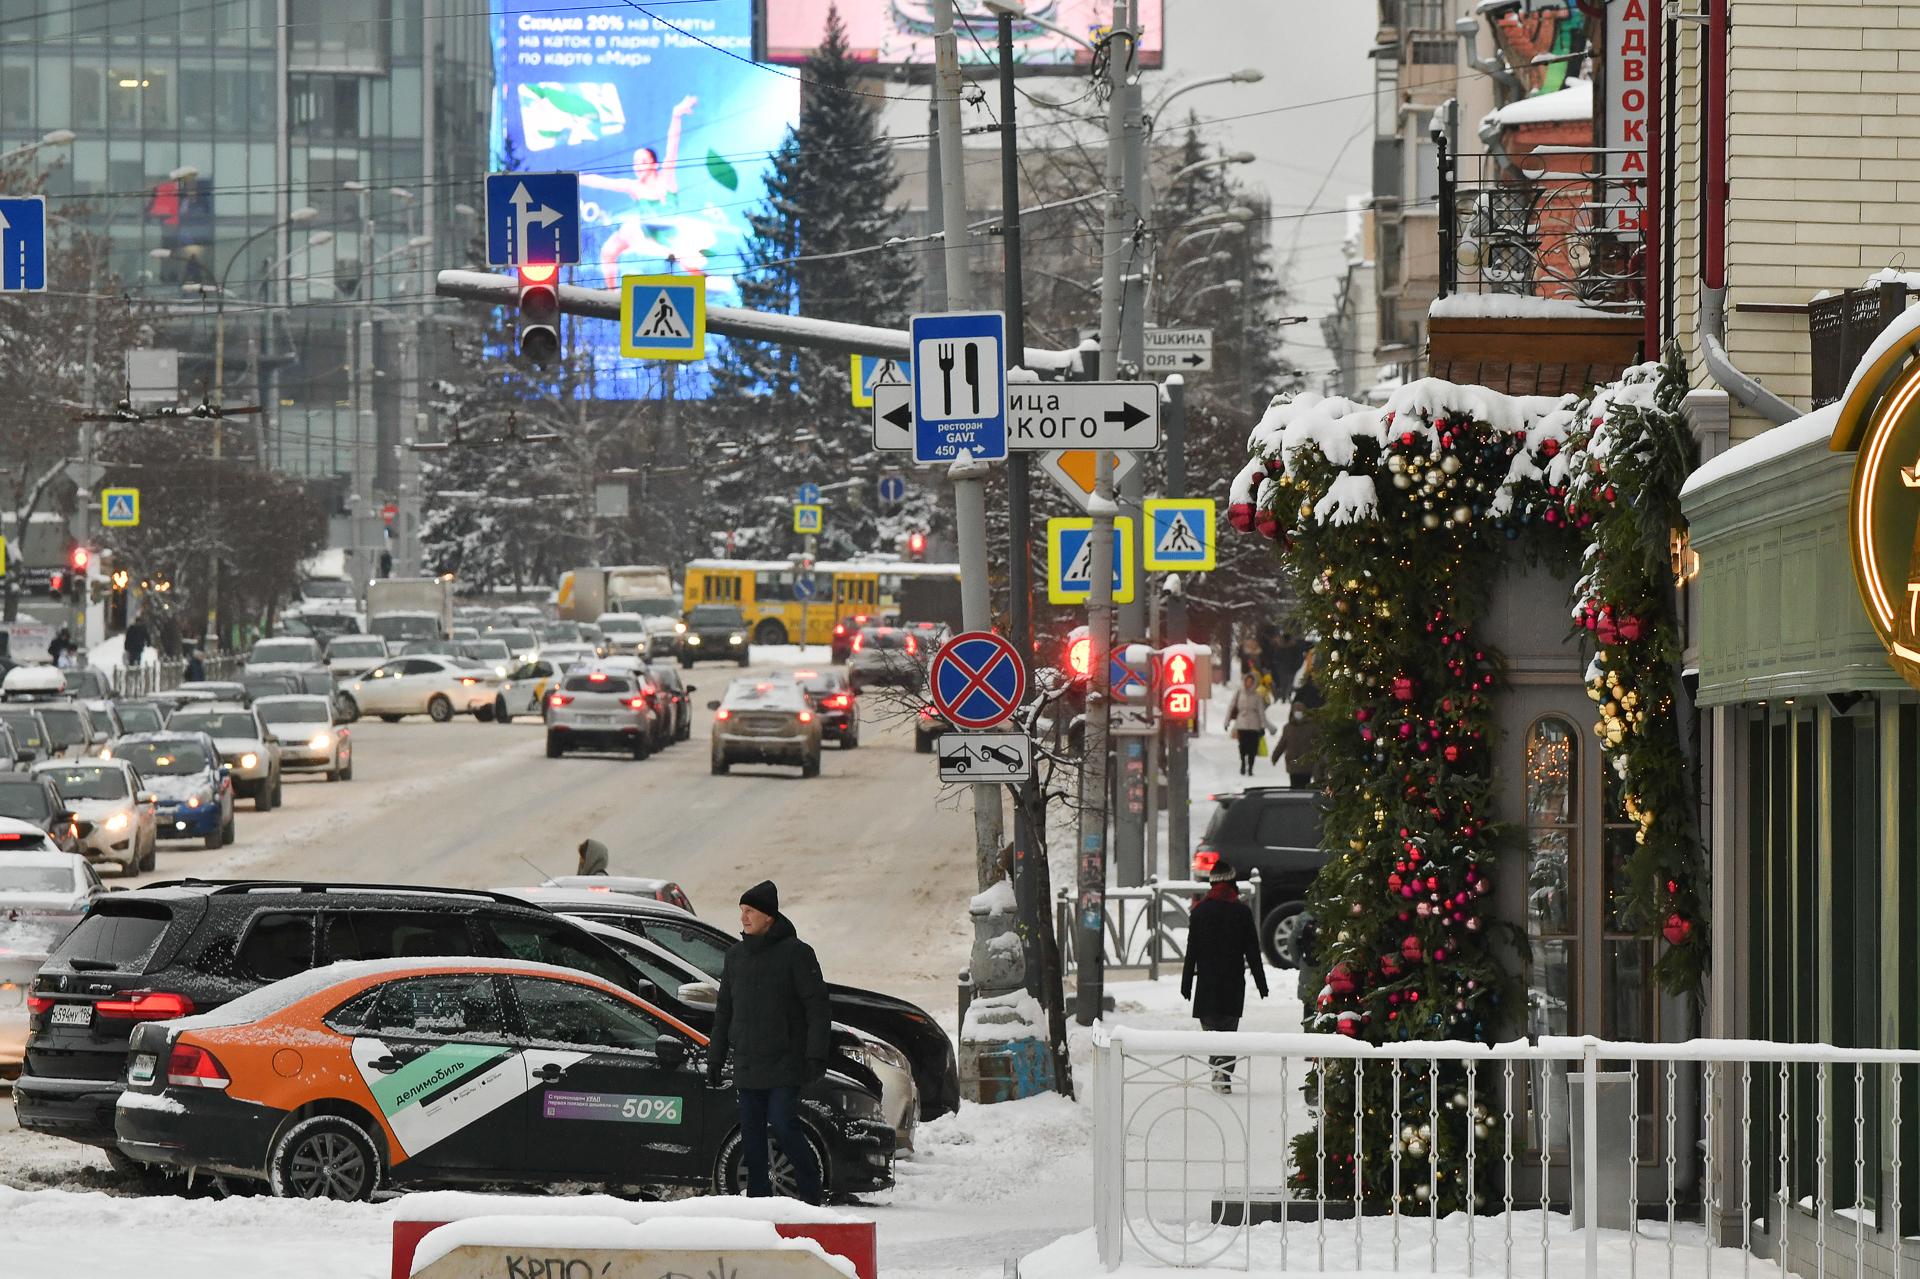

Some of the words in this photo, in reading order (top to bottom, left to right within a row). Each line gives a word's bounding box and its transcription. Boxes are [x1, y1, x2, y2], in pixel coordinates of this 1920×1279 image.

[518, 15, 583, 32] Скидка
[586, 15, 624, 31] 20%
[518, 36, 540, 48] на
[543, 36, 592, 48] каток
[518, 53, 541, 65] по
[544, 53, 593, 67] карте
[1618, 0, 1648, 231] АДВОКАТЫ
[1144, 354, 1177, 366] ОЛЯ
[937, 422, 983, 433] ресторан
[946, 432, 975, 443] GAVI
[935, 445, 955, 456] 450
[1169, 693, 1191, 713] 20
[396, 1062, 465, 1106] делимобиль
[622, 1098, 677, 1120] 50%
